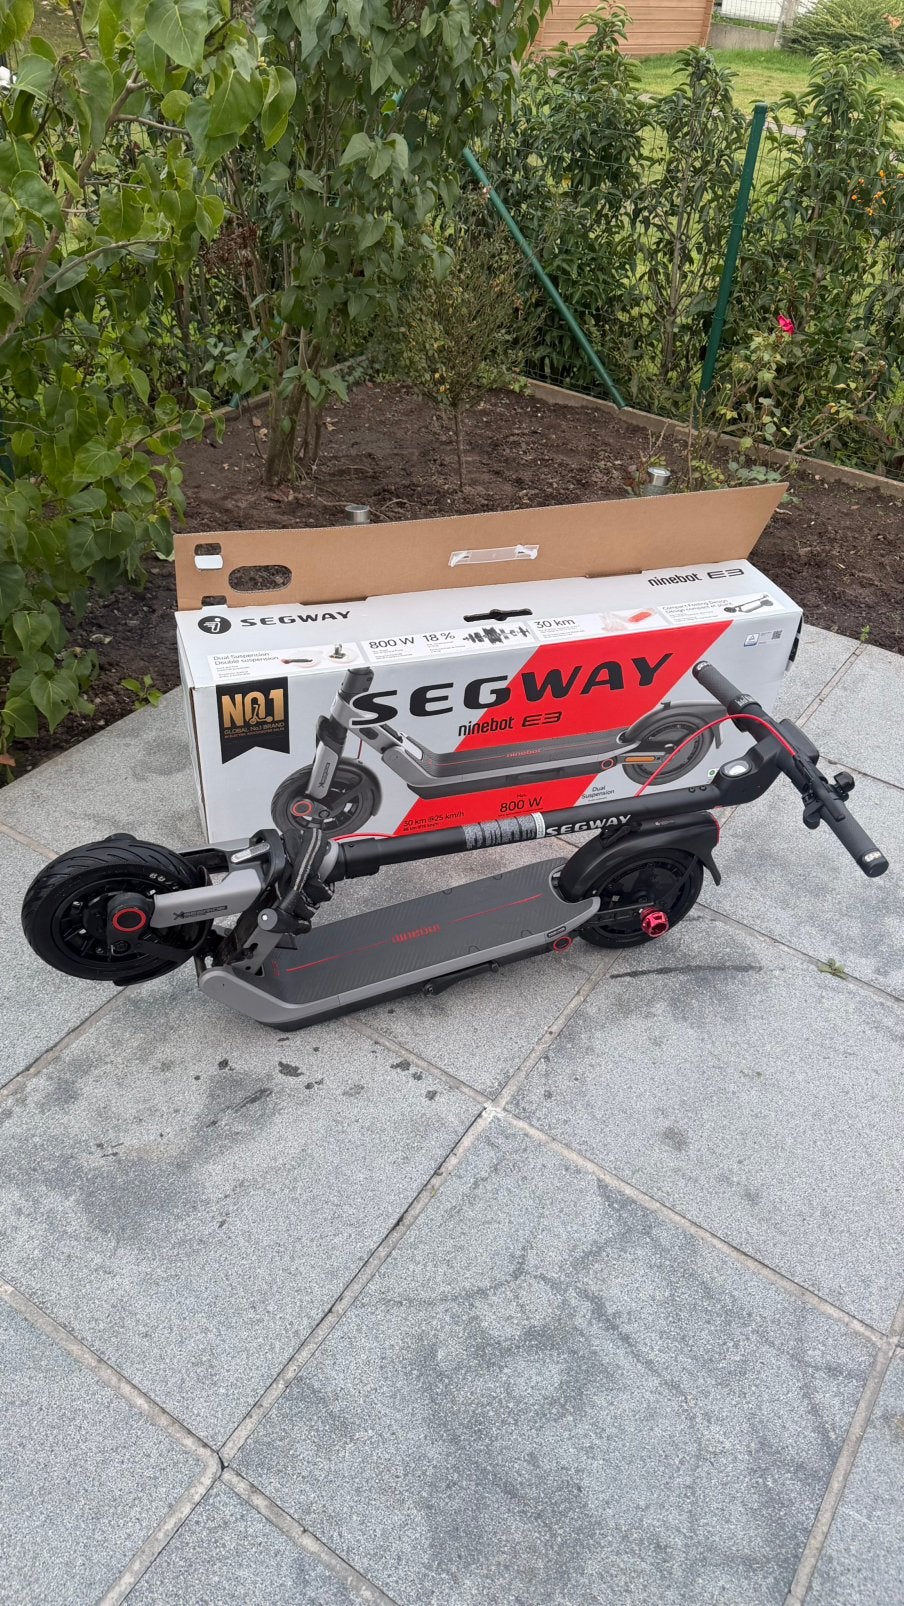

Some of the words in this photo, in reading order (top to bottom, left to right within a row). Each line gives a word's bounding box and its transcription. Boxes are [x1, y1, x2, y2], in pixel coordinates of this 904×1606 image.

[648, 572, 703, 587] ninebot
[240, 610, 351, 627] SEGWAY
[534, 619, 552, 629] 30
[554, 617, 576, 627] km
[368, 639, 397, 649] 800
[398, 637, 415, 645] W
[422, 633, 439, 642] 18
[440, 632, 455, 640] %
[350, 652, 675, 727] SEGWAY
[263, 722, 285, 730] BRAND
[458, 716, 514, 738] ninebot
[582, 789, 615, 800] Suspension
[499, 800, 525, 813] 800
[528, 796, 543, 808] W
[403, 819, 414, 827] 30
[445, 810, 465, 820] km/h
[546, 814, 632, 836] SEGWAY
